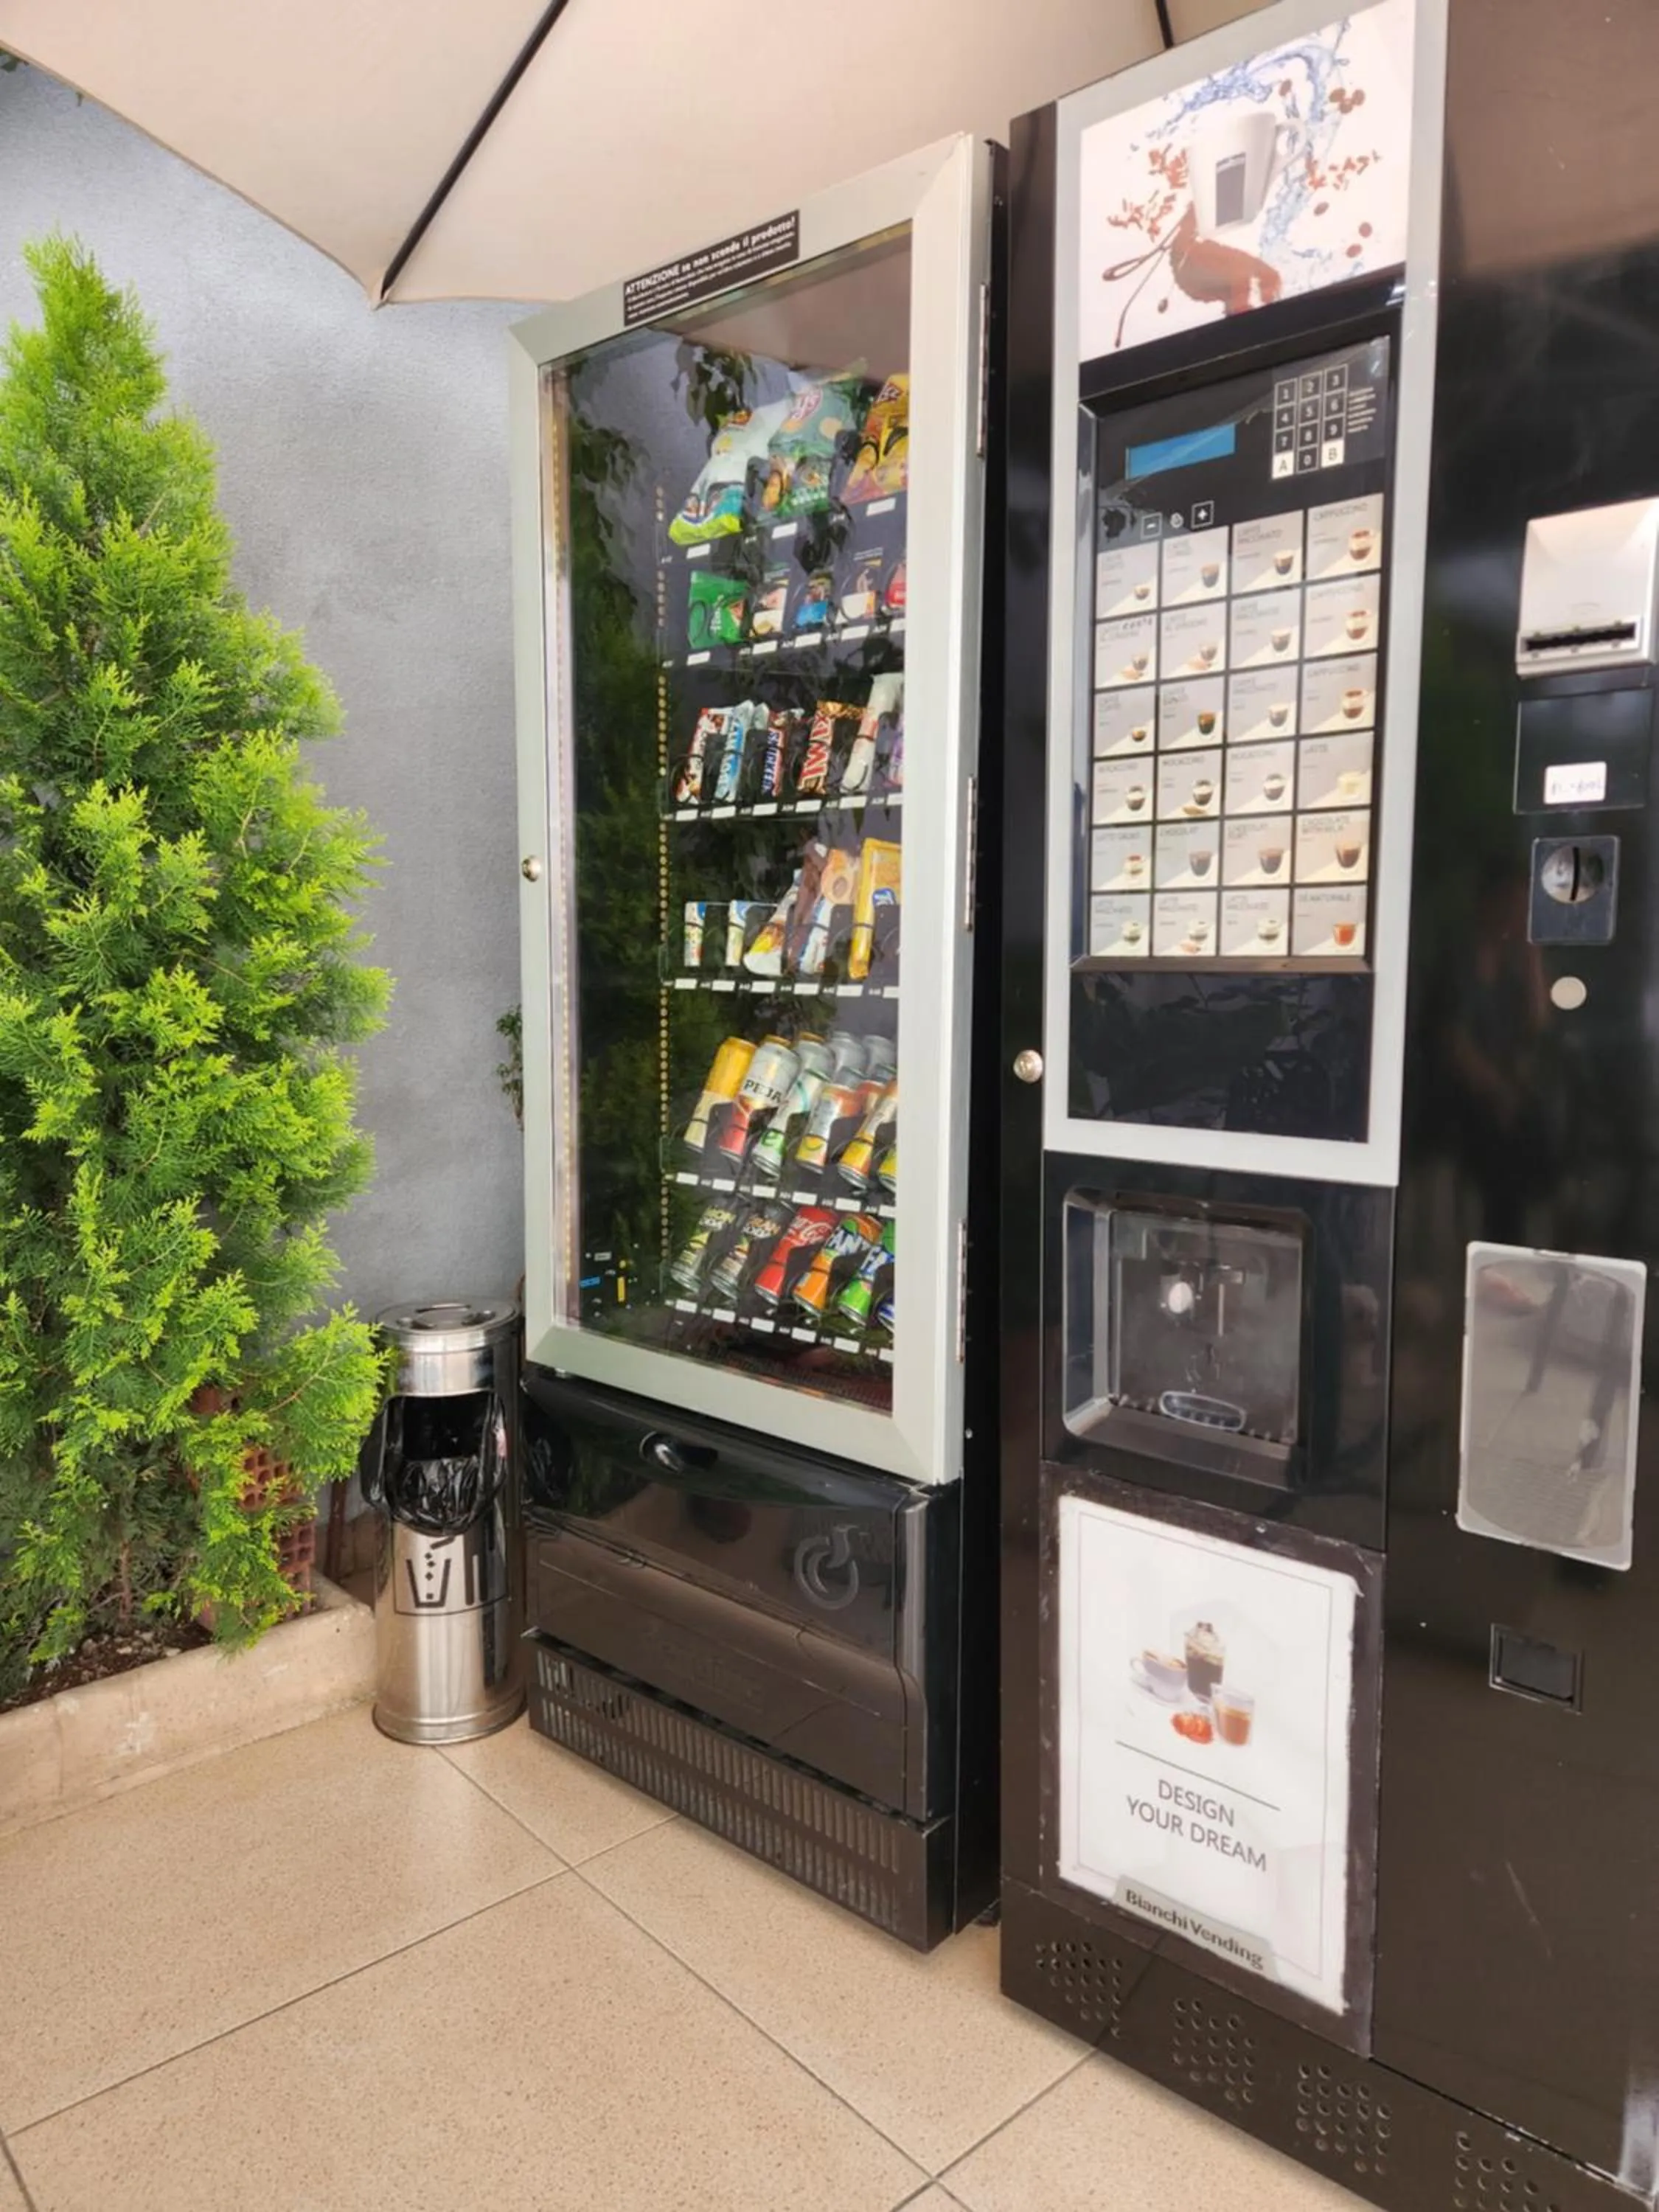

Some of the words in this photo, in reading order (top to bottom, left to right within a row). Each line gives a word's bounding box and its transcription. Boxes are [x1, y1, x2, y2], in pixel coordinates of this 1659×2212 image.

[1282, 388, 1290, 400] 1
[1306, 380, 1315, 394] 2
[1332, 374, 1340, 387] 3
[1281, 412, 1289, 423] 4
[1305, 406, 1314, 418] 5
[1330, 398, 1339, 411] 6
[1281, 436, 1289, 448] 7
[1304, 430, 1312, 442] 8
[1329, 423, 1338, 437] 9
[1279, 459, 1288, 473] A
[1327, 447, 1338, 462] B
[1158, 1778, 1235, 1828] DESIGN
[1126, 1794, 1184, 1837] YOUR
[1190, 1821, 1267, 1872] DREAM
[1125, 1888, 1188, 1930] Bianchi
[1189, 1919, 1265, 1972] Vending
